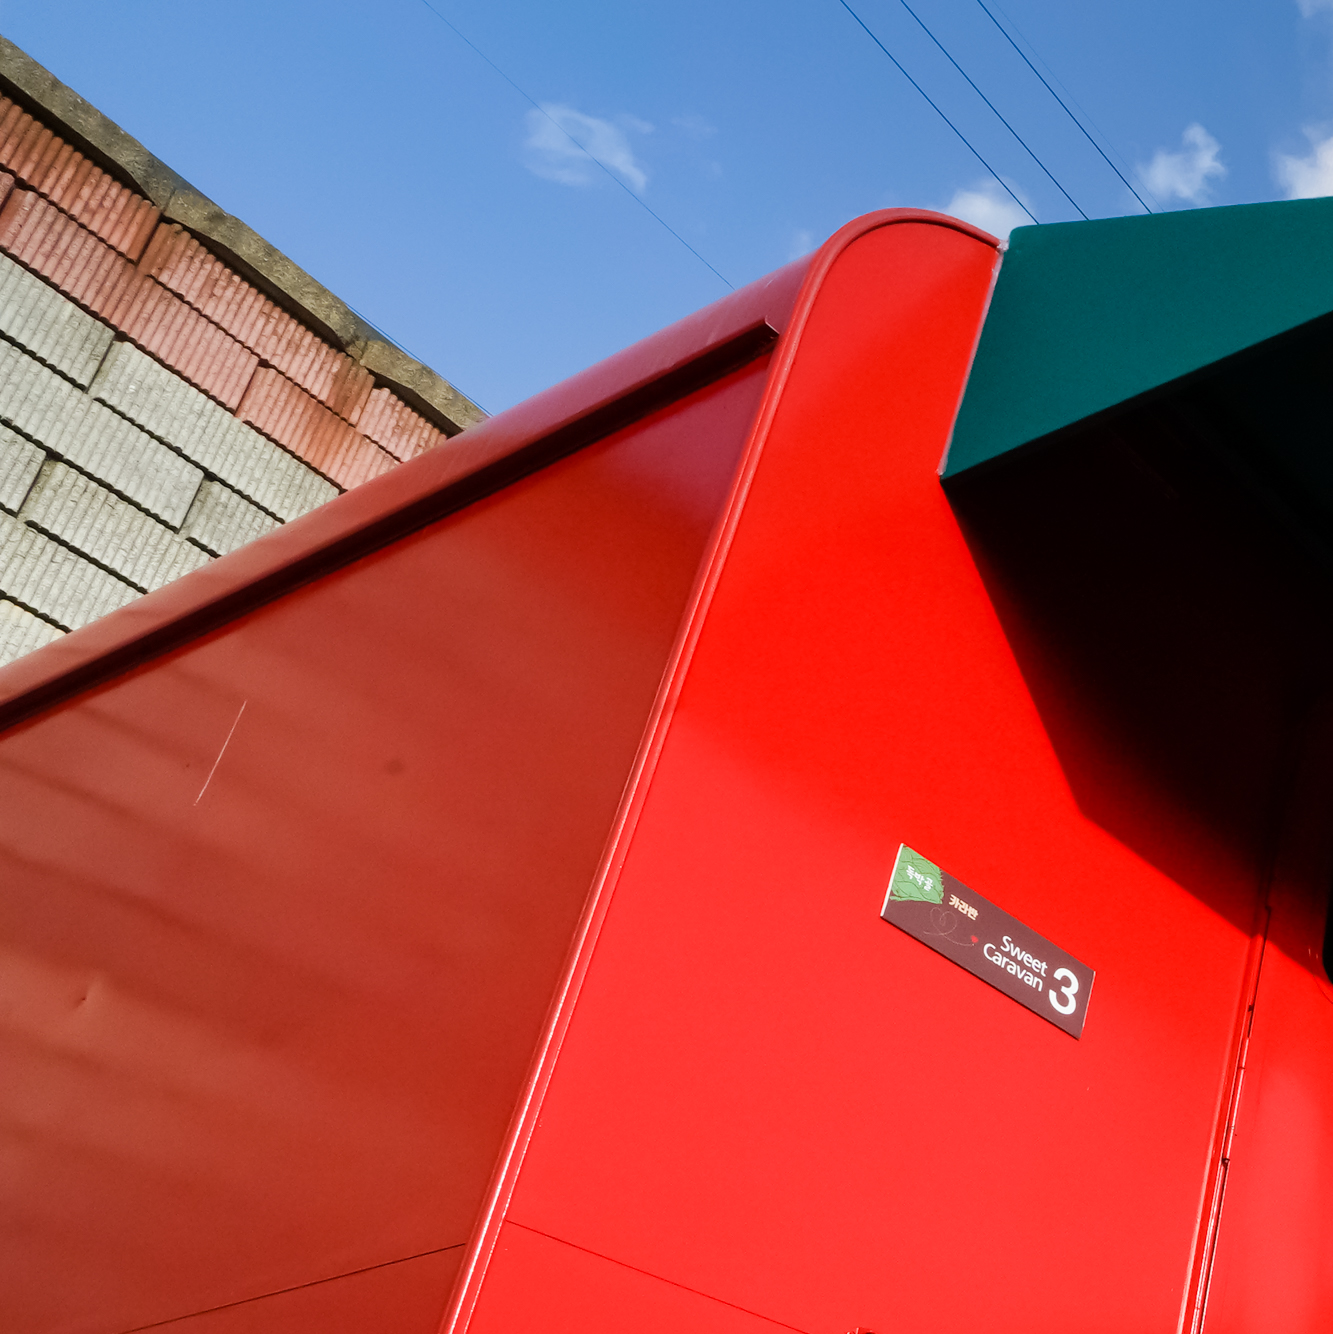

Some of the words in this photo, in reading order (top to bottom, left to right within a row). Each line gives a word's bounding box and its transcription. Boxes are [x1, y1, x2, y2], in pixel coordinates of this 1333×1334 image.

[949, 894, 978, 920] 카라반
[983, 943, 1043, 991] Caravan
[1000, 935, 1048, 977] Sweet
[1049, 967, 1079, 1015] 3
